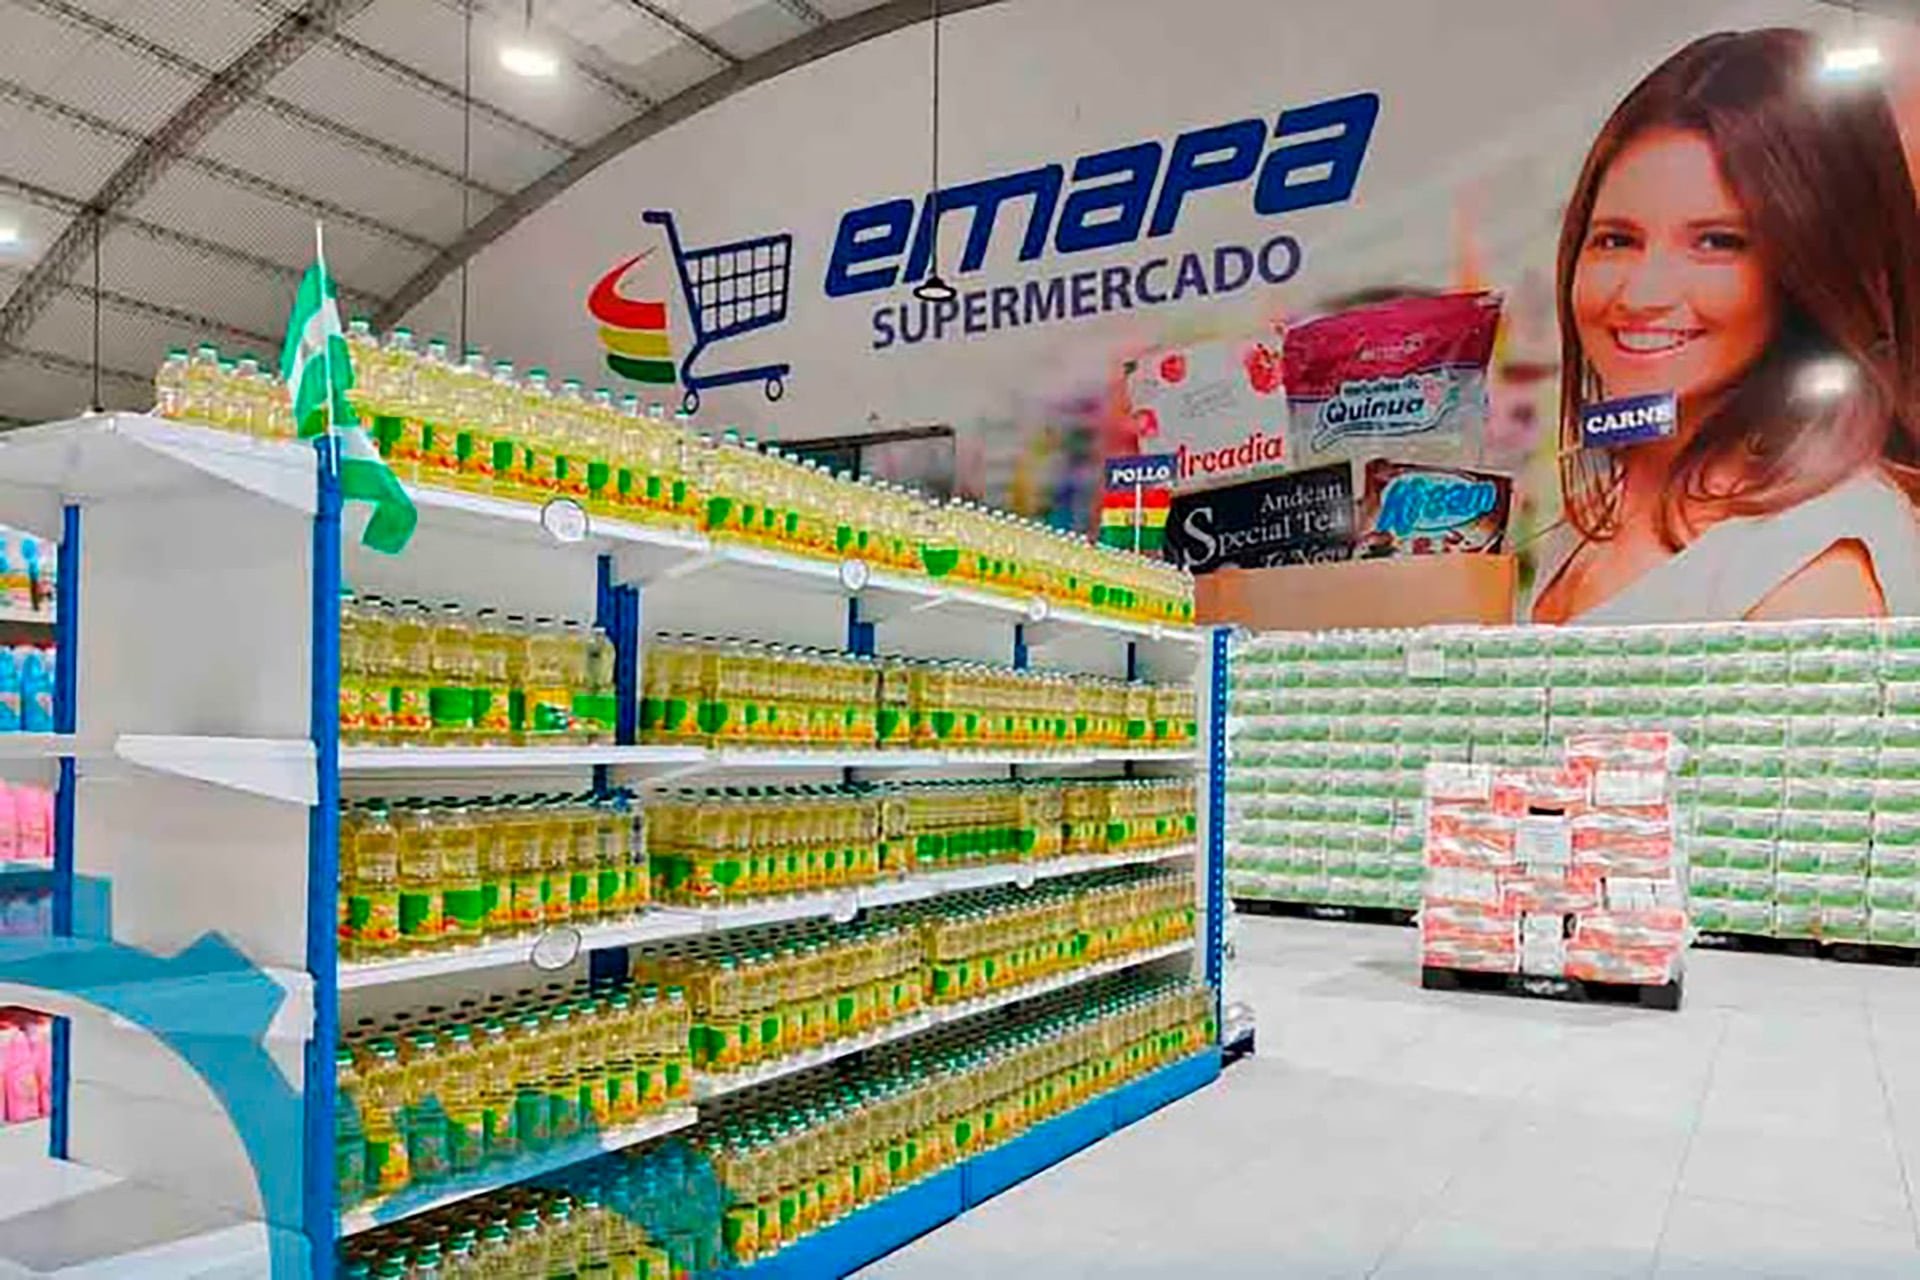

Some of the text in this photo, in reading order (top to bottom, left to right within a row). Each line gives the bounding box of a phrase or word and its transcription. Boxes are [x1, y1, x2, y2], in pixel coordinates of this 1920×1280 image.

[872, 236, 1301, 349] SUPERMERCADO
[1326, 397, 1425, 424] Quinua
[1586, 403, 1671, 434] CARNE
[1110, 464, 1170, 486] POLLO
[1260, 483, 1343, 514] Andean
[1183, 507, 1347, 566] Special Tea
